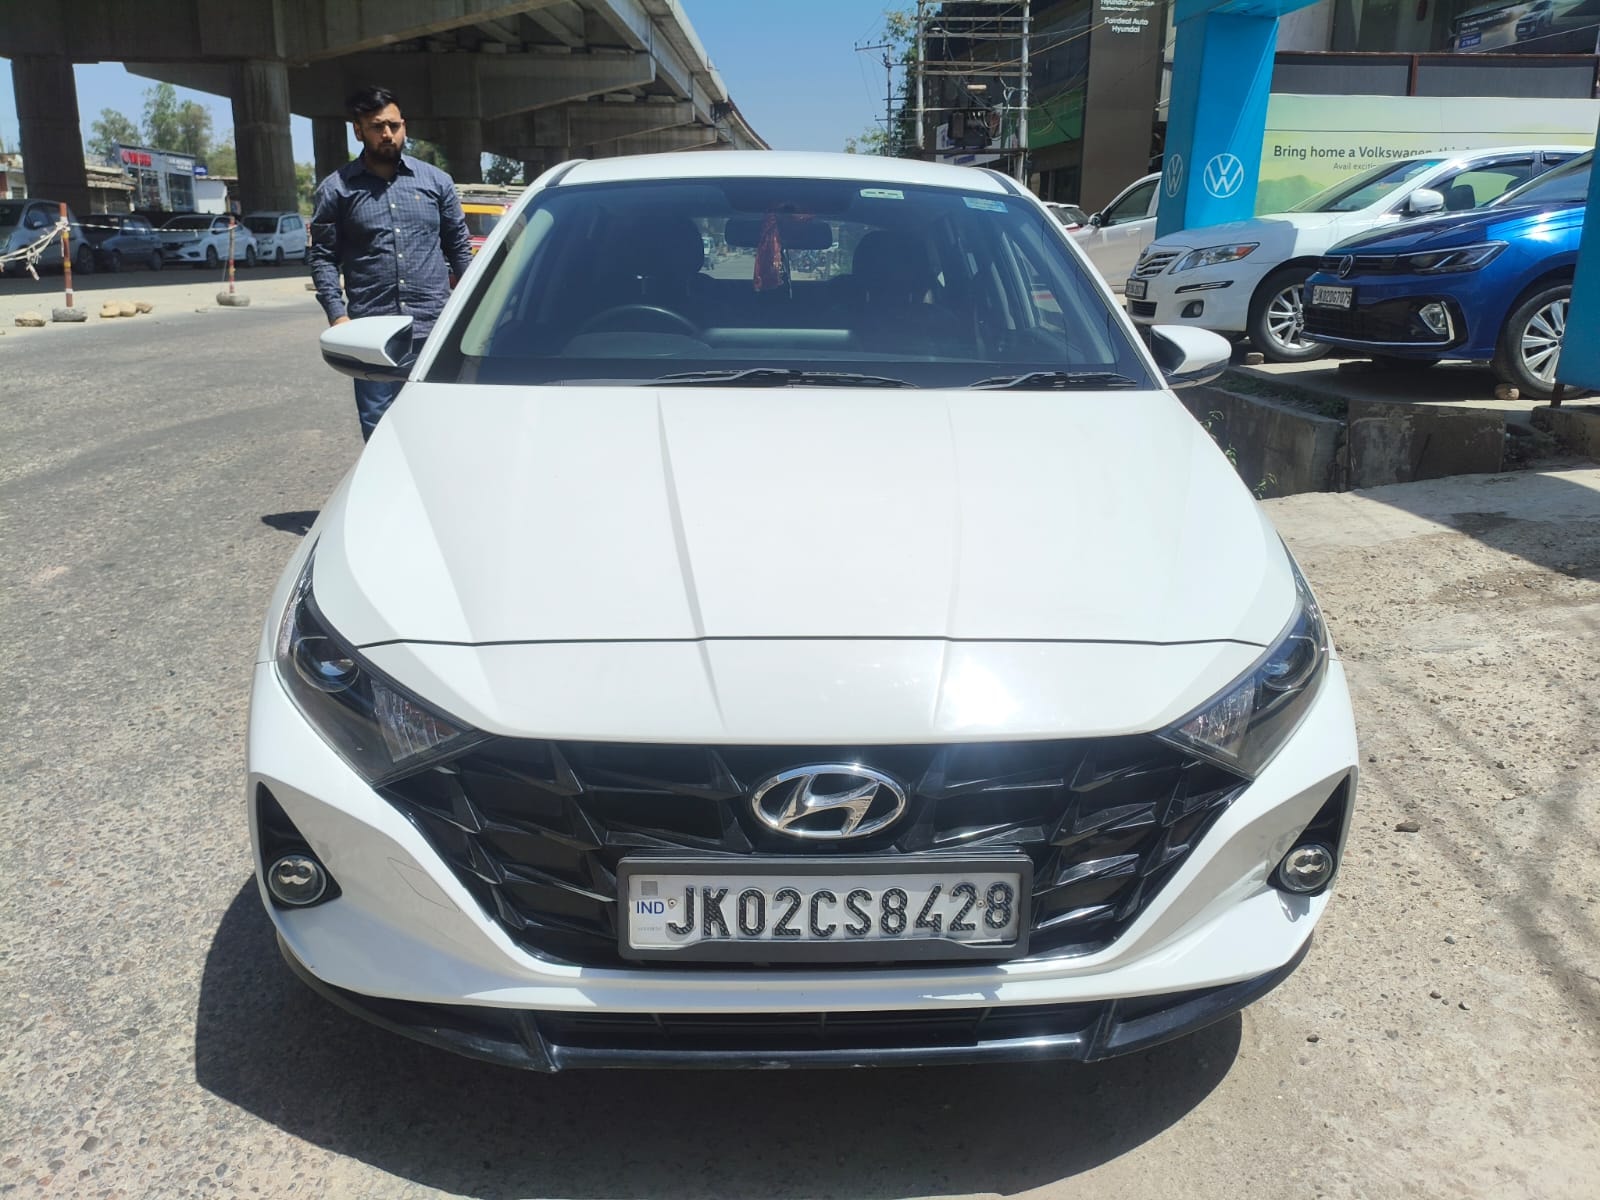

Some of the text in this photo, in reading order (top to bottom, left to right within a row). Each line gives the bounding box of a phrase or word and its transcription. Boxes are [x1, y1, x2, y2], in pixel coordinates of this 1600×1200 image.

[1111, 25, 1140, 33] Hyundai
[1273, 145, 1307, 160] Bring
[1310, 146, 1345, 158] home
[1348, 149, 1356, 158] a
[1333, 162, 1352, 170] Avail
[636, 901, 665, 915] IND
[667, 883, 1014, 937] JK02CS8428
